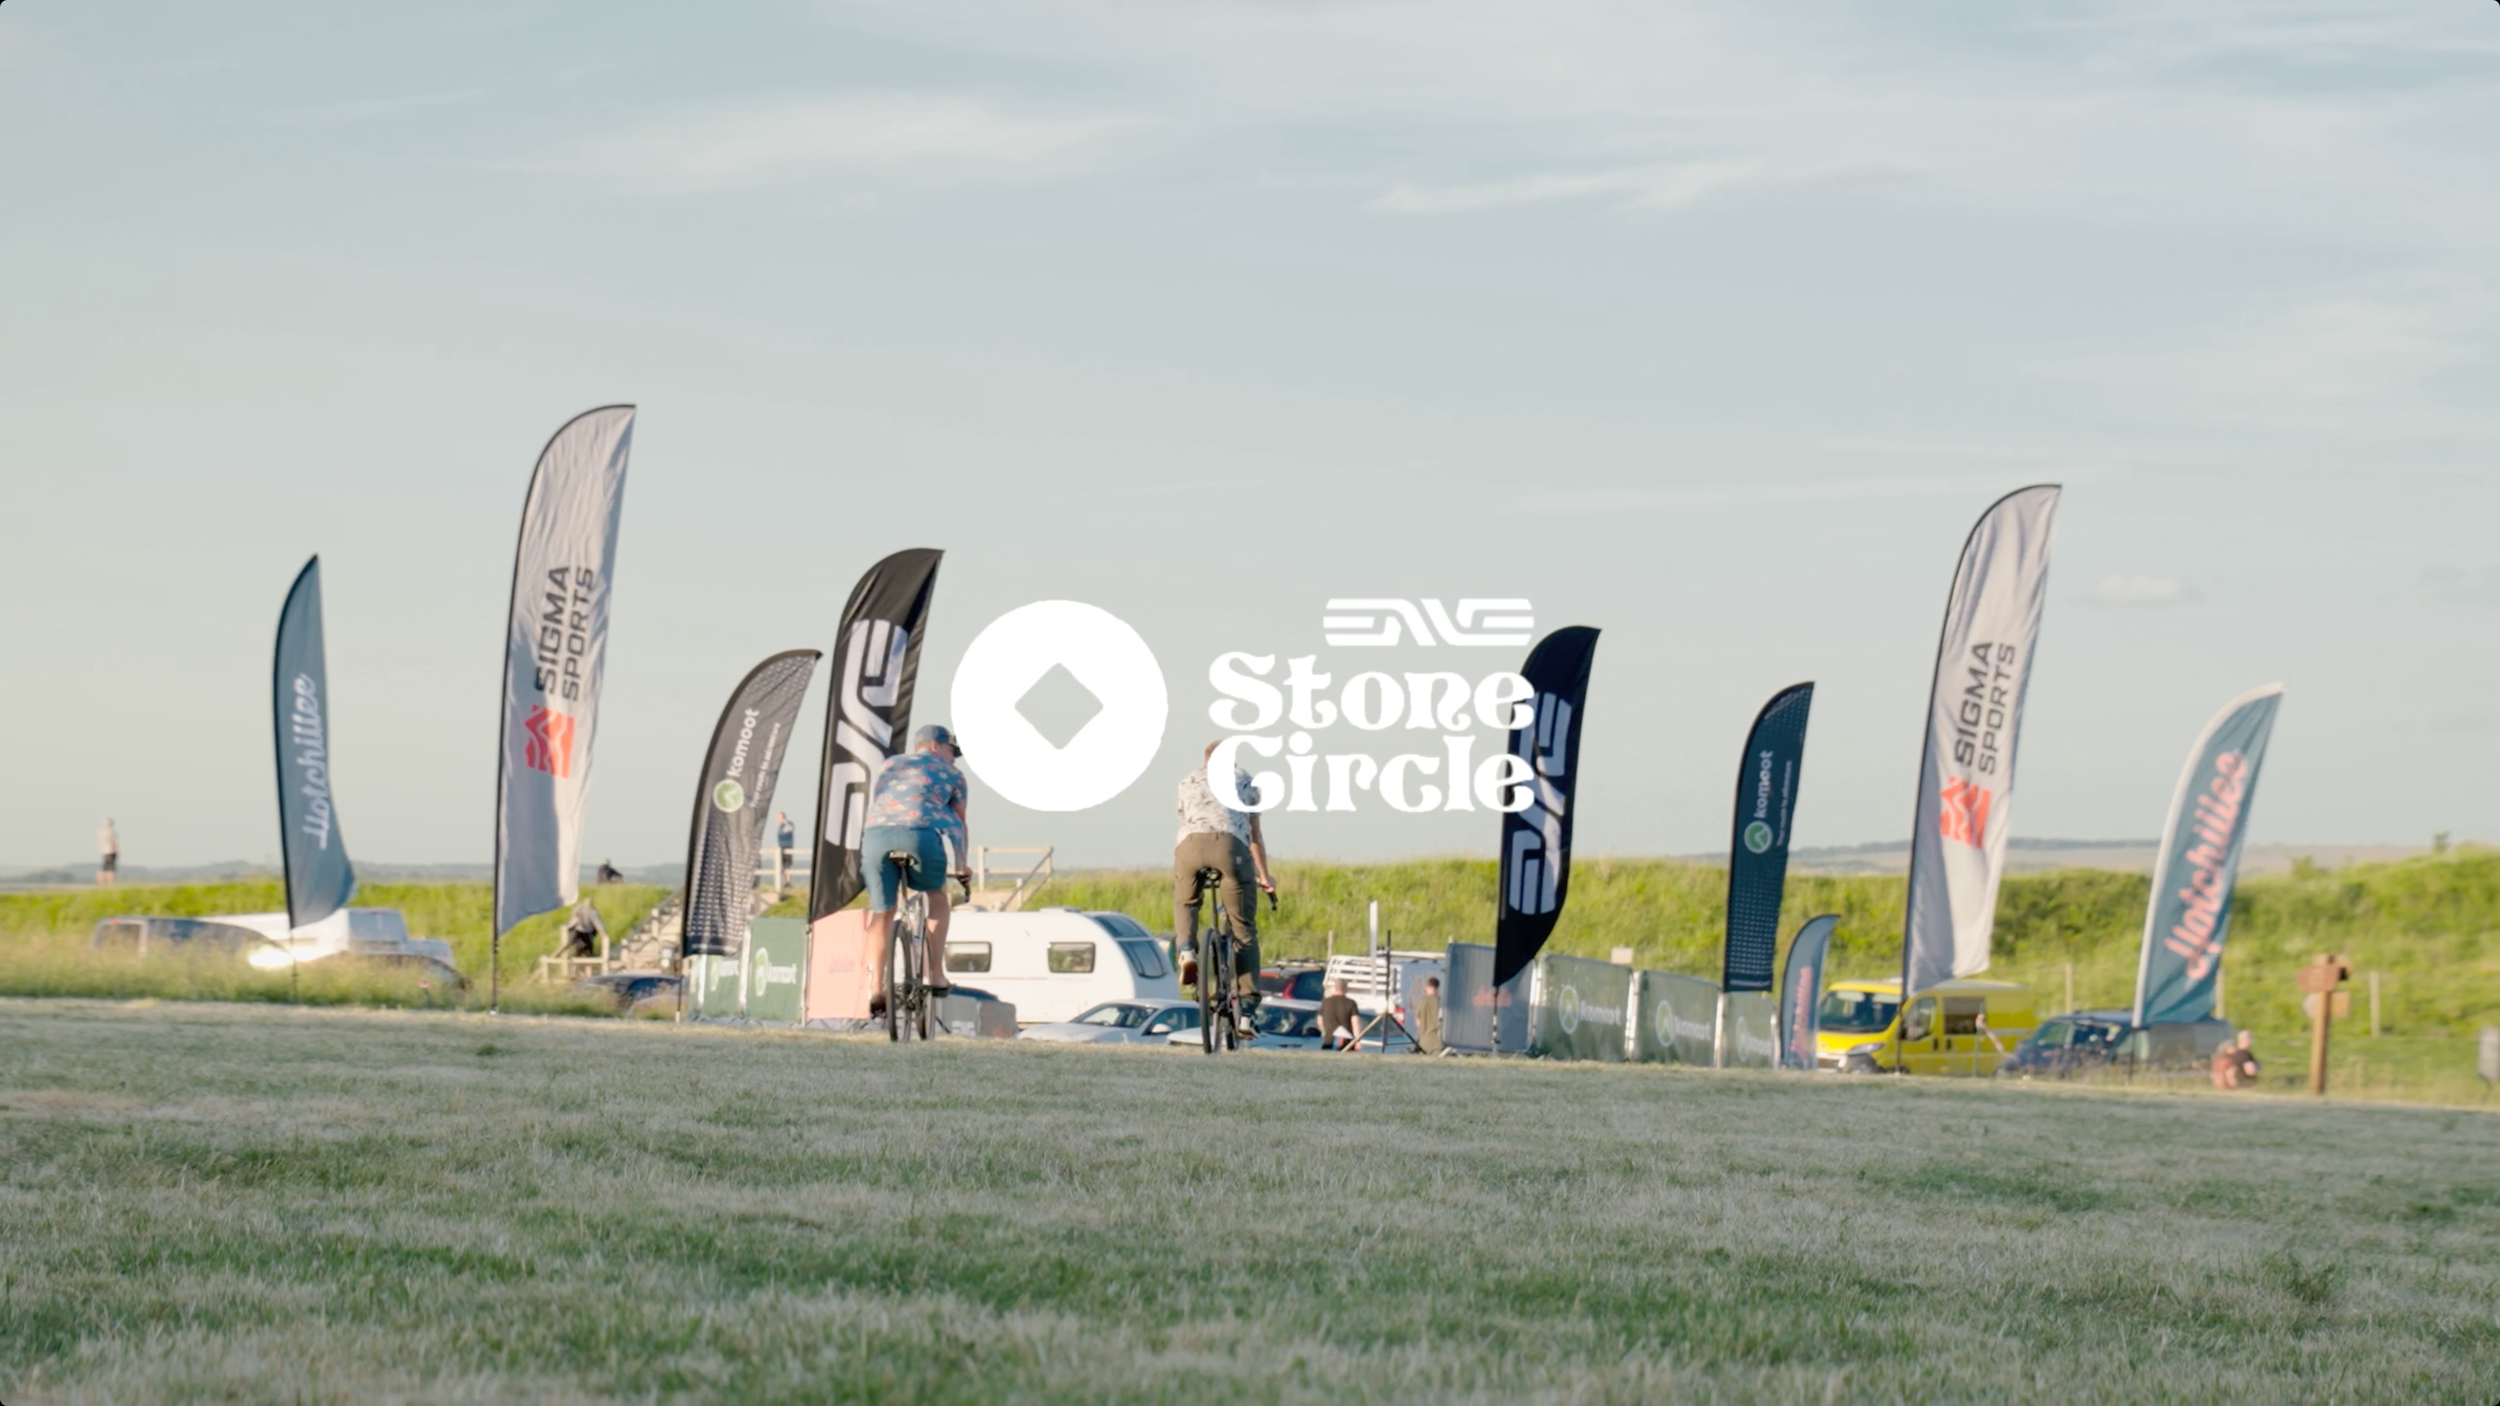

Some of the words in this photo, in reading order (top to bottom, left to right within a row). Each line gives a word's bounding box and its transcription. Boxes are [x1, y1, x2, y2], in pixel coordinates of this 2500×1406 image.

[534, 566, 569, 694] SIGMA
[562, 566, 594, 702] SPORTS
[726, 707, 760, 778] komoot
[1954, 641, 1993, 768] SIGMA
[1978, 643, 2016, 775] SPORTS
[1753, 749, 1774, 818] komoot
